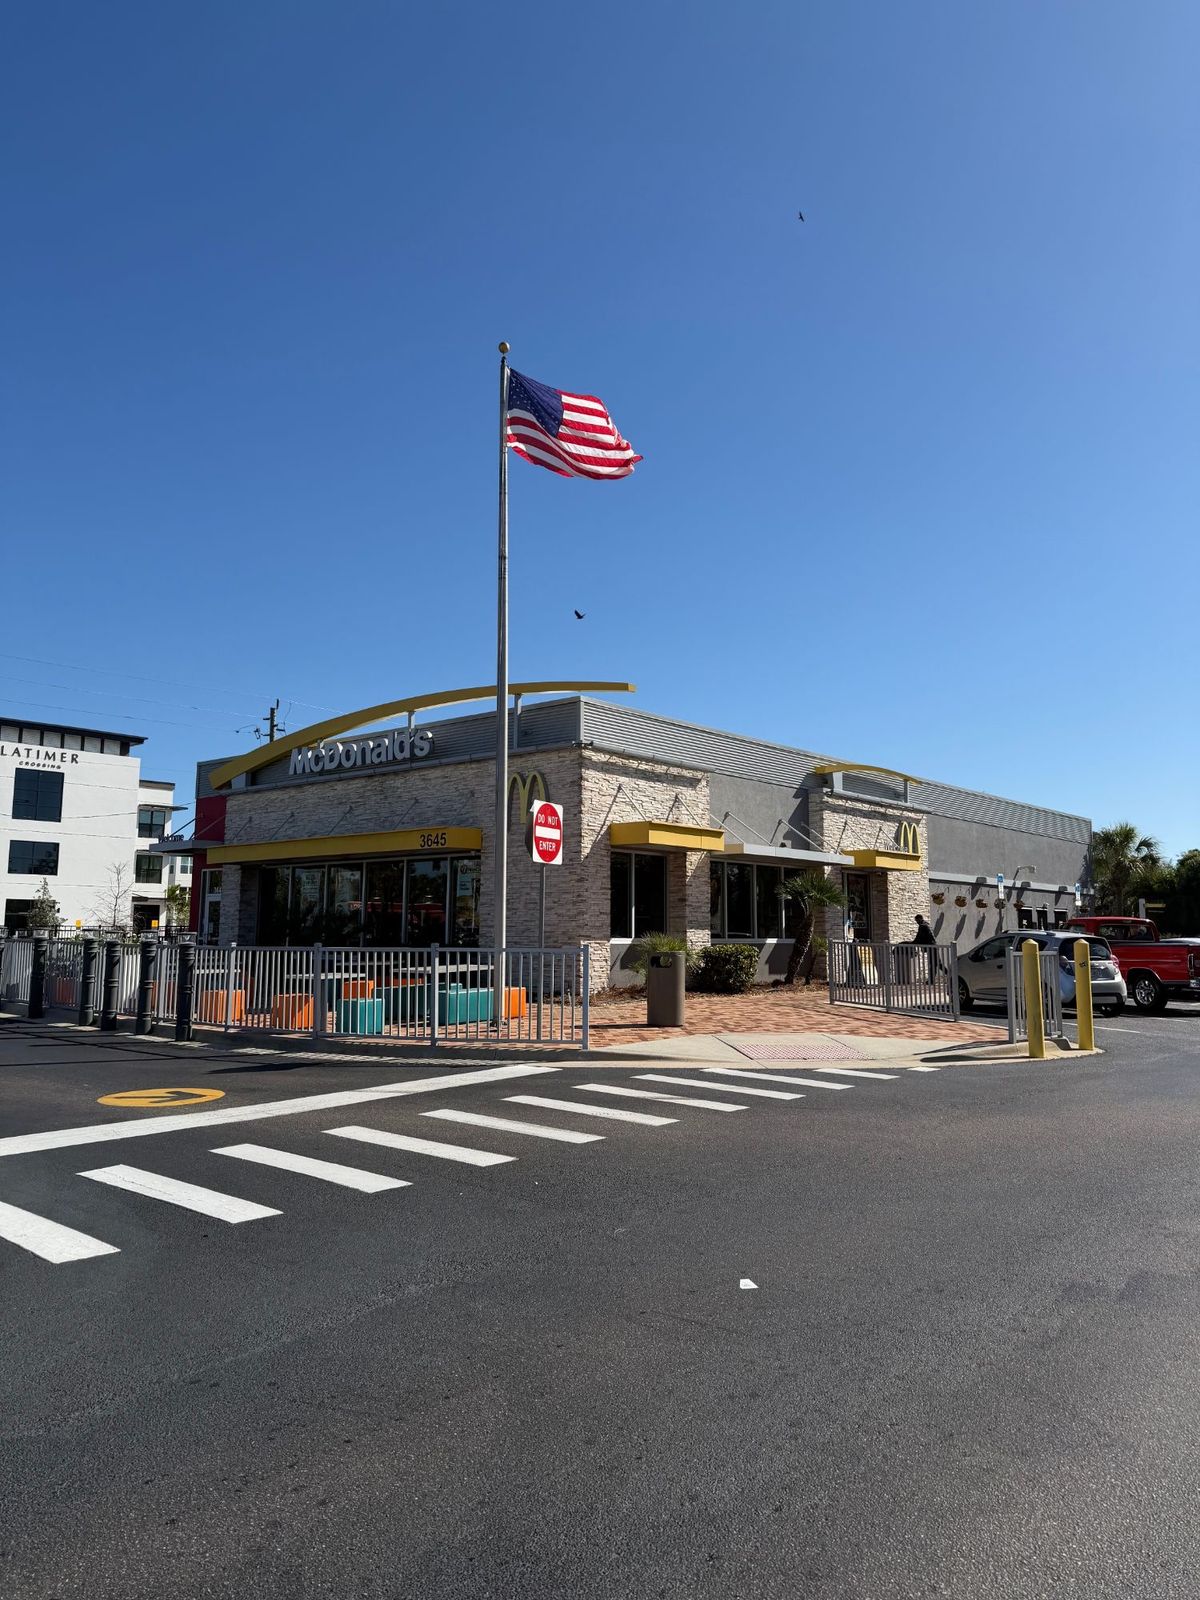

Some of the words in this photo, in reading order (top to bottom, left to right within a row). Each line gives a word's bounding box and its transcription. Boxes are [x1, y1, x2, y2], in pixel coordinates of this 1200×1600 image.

[0, 745, 79, 764] LATIMER
[288, 730, 432, 775] McDonald's
[537, 813, 545, 823] DO
[547, 816, 558, 826] NOT
[419, 832, 447, 848] 3645
[539, 840, 556, 852] ENTER
